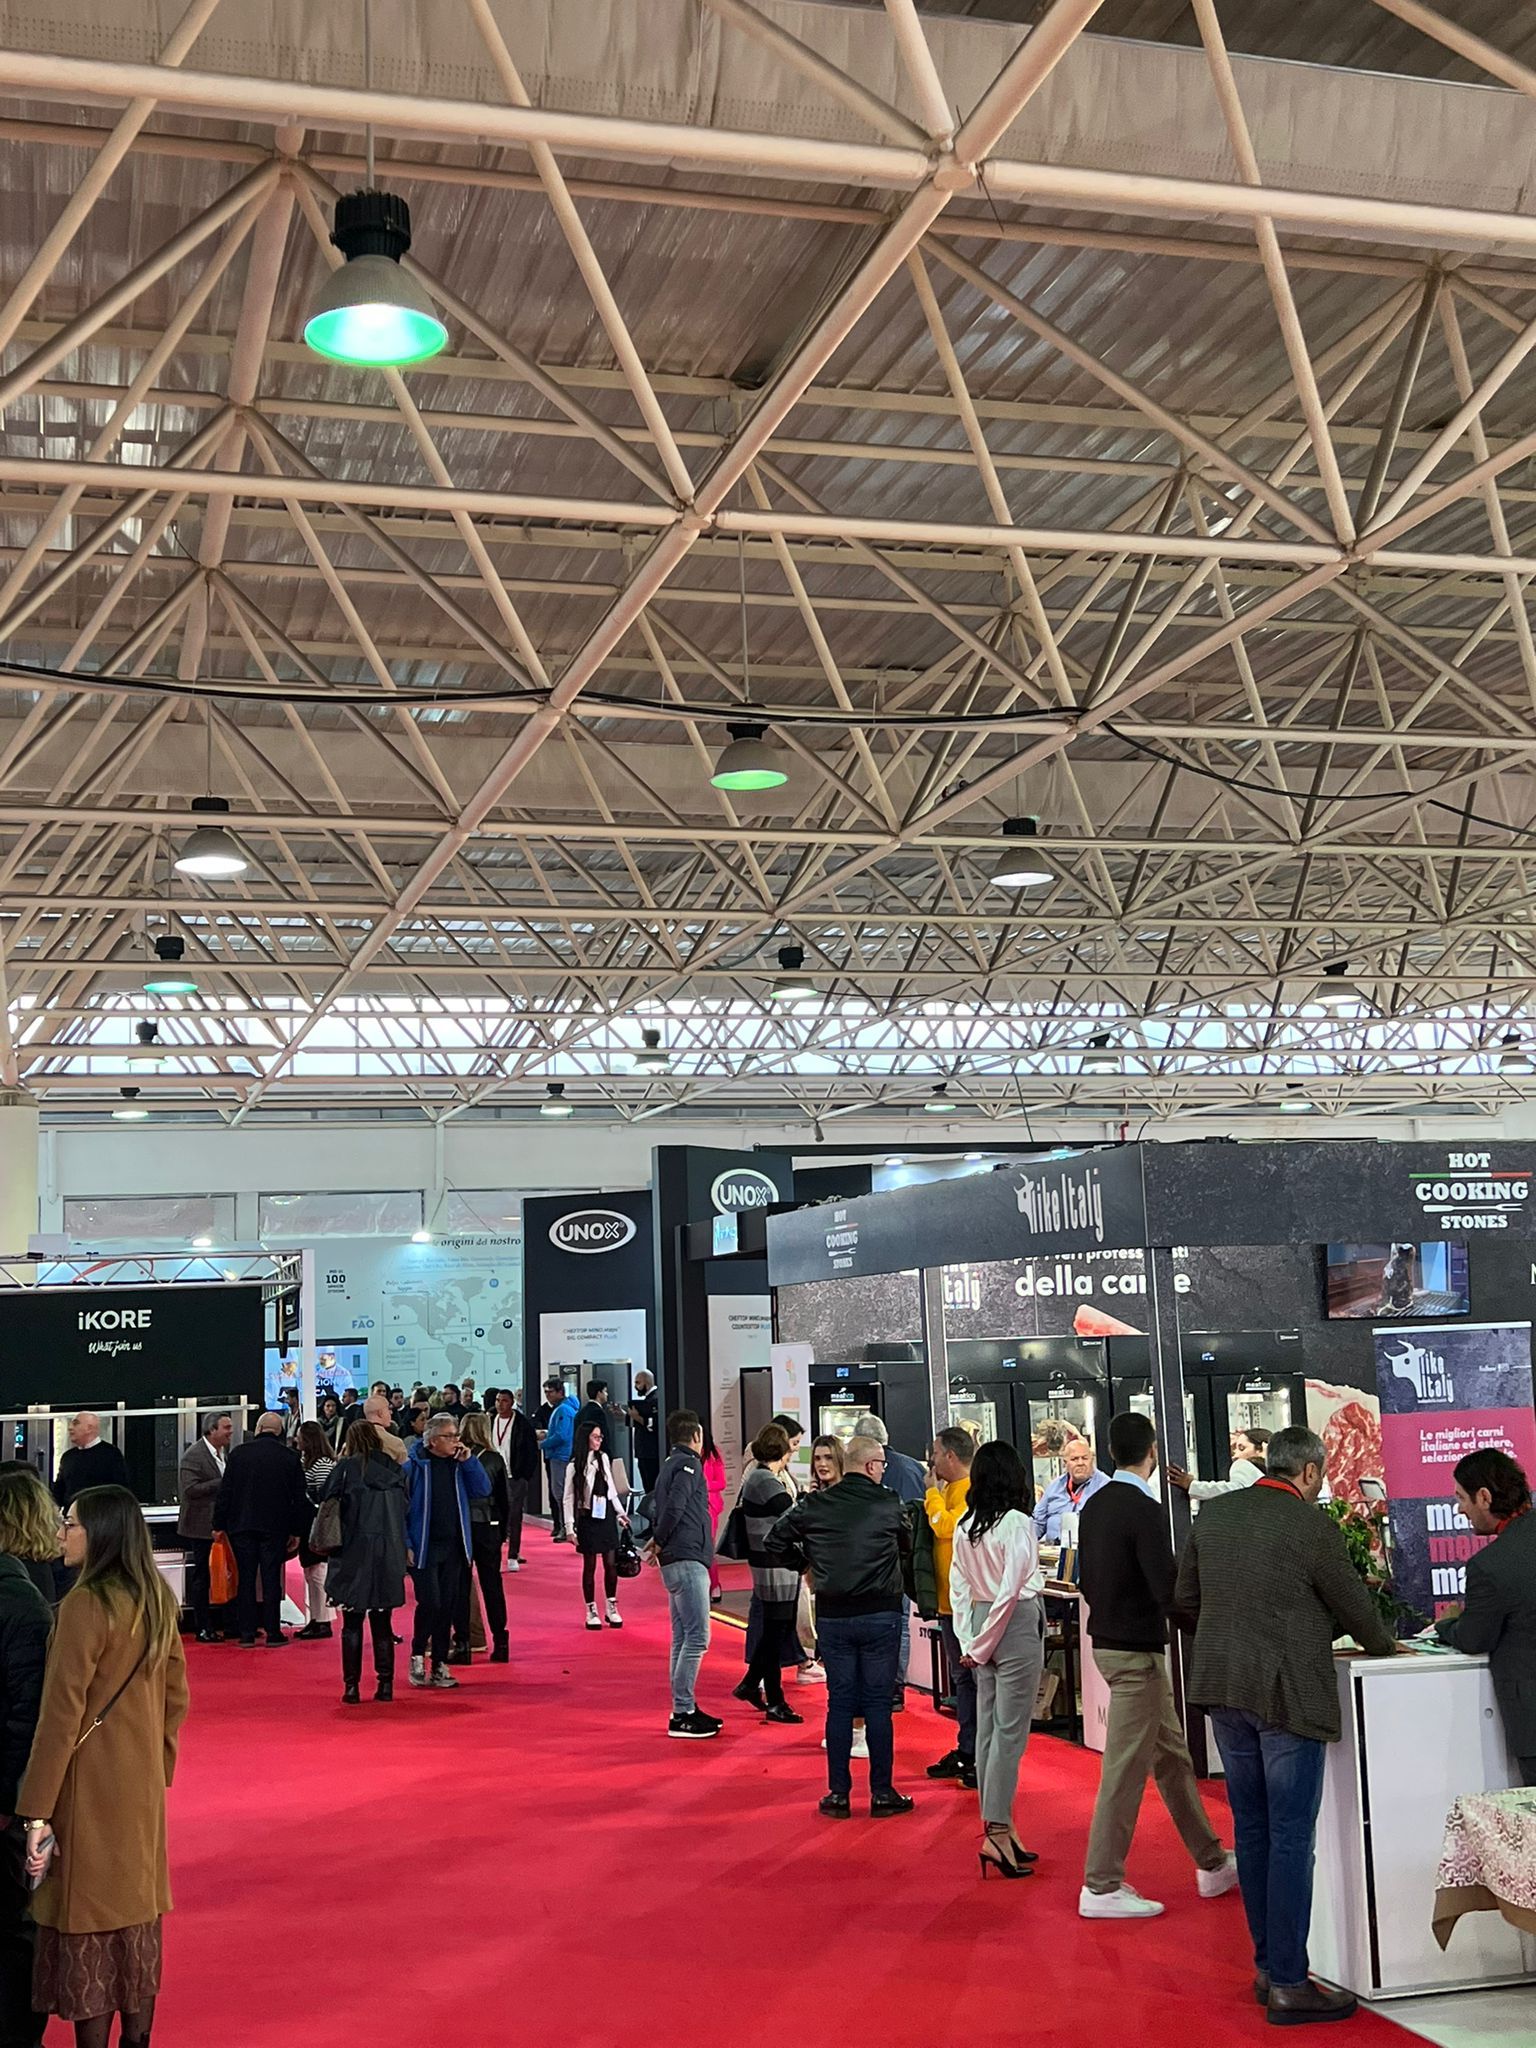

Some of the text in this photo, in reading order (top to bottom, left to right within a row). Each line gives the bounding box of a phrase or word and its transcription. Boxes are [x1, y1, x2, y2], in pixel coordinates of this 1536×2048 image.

[1448, 1153, 1491, 1168] HOT
[1415, 1182, 1529, 1201] COOKING
[1441, 1215, 1508, 1229] STONES
[441, 1239, 474, 1249] origini
[326, 1275, 346, 1283] 100
[1014, 1264, 1093, 1296] della
[78, 1309, 152, 1330] iKORE
[352, 1319, 375, 1328] FAO
[1420, 1425, 1504, 1441] Le migliori carni
[1421, 1440, 1460, 1452] italiane
[1462, 1438, 1476, 1449] ed
